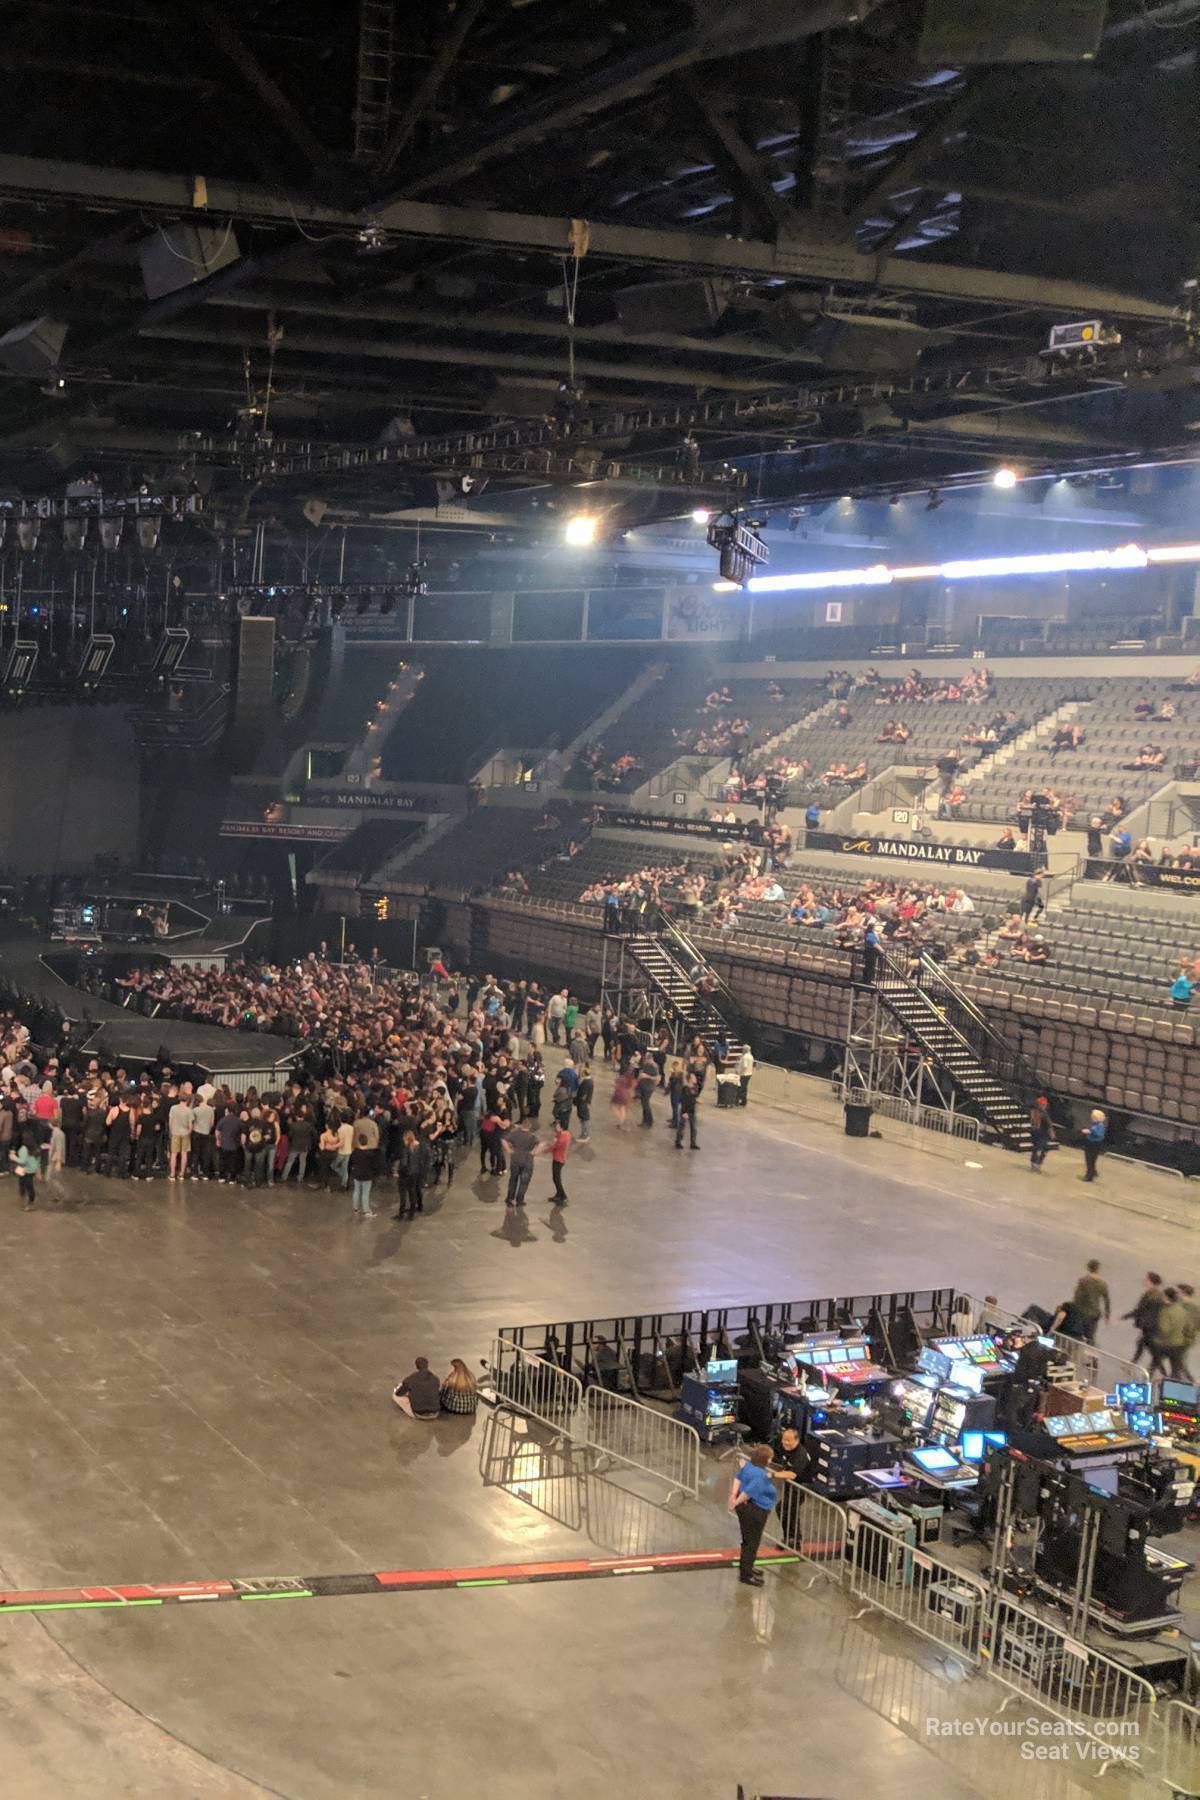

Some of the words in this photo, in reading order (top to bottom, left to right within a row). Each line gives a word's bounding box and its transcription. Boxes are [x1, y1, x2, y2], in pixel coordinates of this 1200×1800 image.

[337, 795, 394, 806] MANDALAY
[397, 799, 414, 807] BAY
[894, 811, 908, 823] 120
[878, 842, 952, 860] MANDALAY
[956, 850, 981, 863] BAY
[1159, 873, 1200, 884] WELCO
